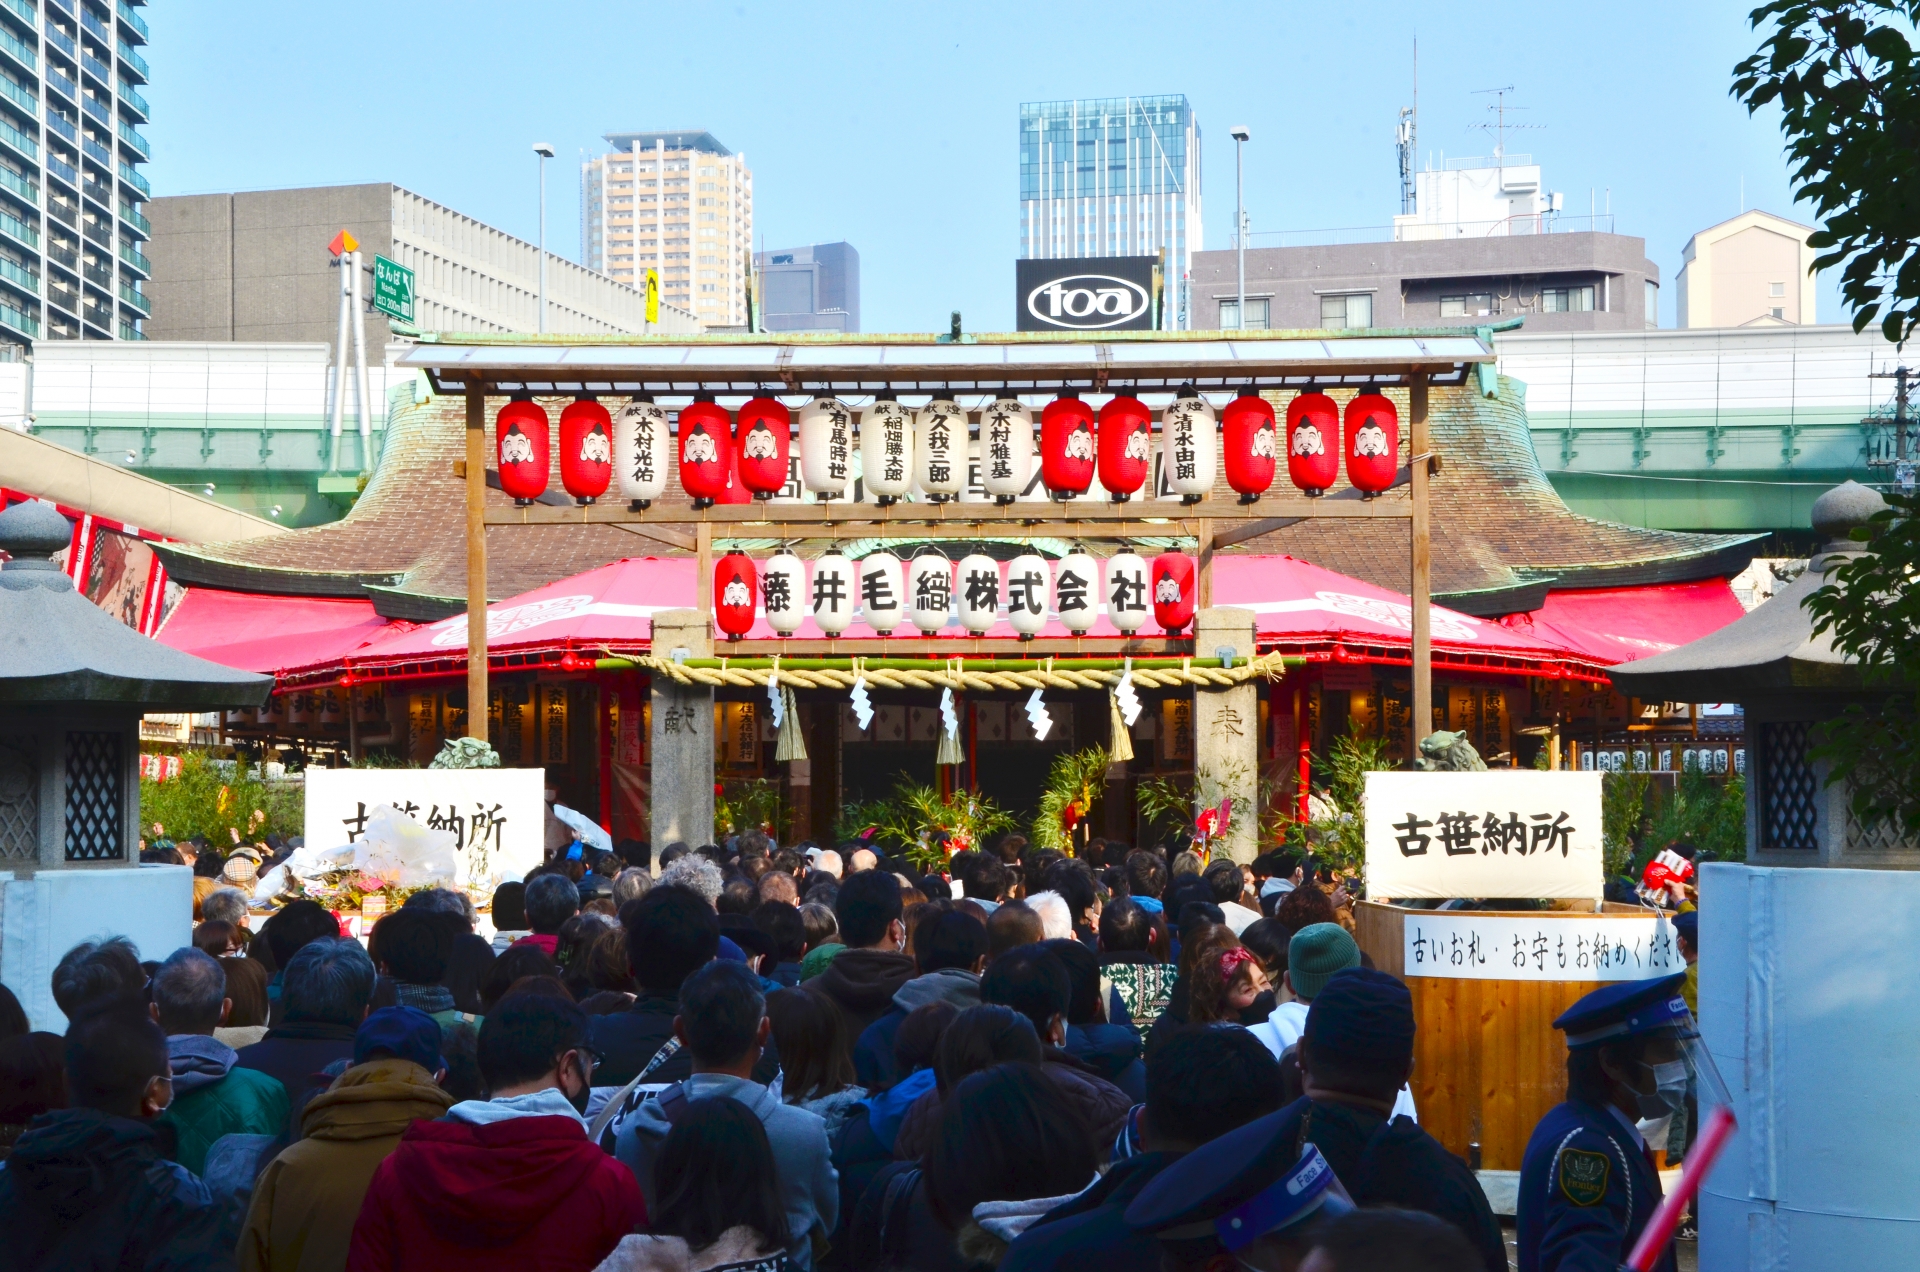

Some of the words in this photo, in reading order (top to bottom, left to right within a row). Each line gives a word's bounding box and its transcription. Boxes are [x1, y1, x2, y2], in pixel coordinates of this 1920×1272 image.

[377, 262, 401, 286] なんば
[377, 293, 386, 306] 出口
[387, 297, 401, 313] 200m
[1043, 283, 1132, 317] toa
[625, 405, 663, 419] 献燈
[923, 403, 961, 416] 献燈
[986, 402, 1022, 414] 献燈
[1166, 401, 1204, 415] 献燈
[828, 410, 848, 480] 有馬時世
[883, 416, 904, 482] 稲畑勝太郎
[928, 414, 951, 484] 久我三郎
[990, 412, 1013, 479] 木村雅基
[1173, 413, 1196, 480] 清水由朗
[1211, 704, 1244, 743] 奉
[1391, 810, 1576, 858] 古笹納所
[1296, 1167, 1318, 1188] Face
